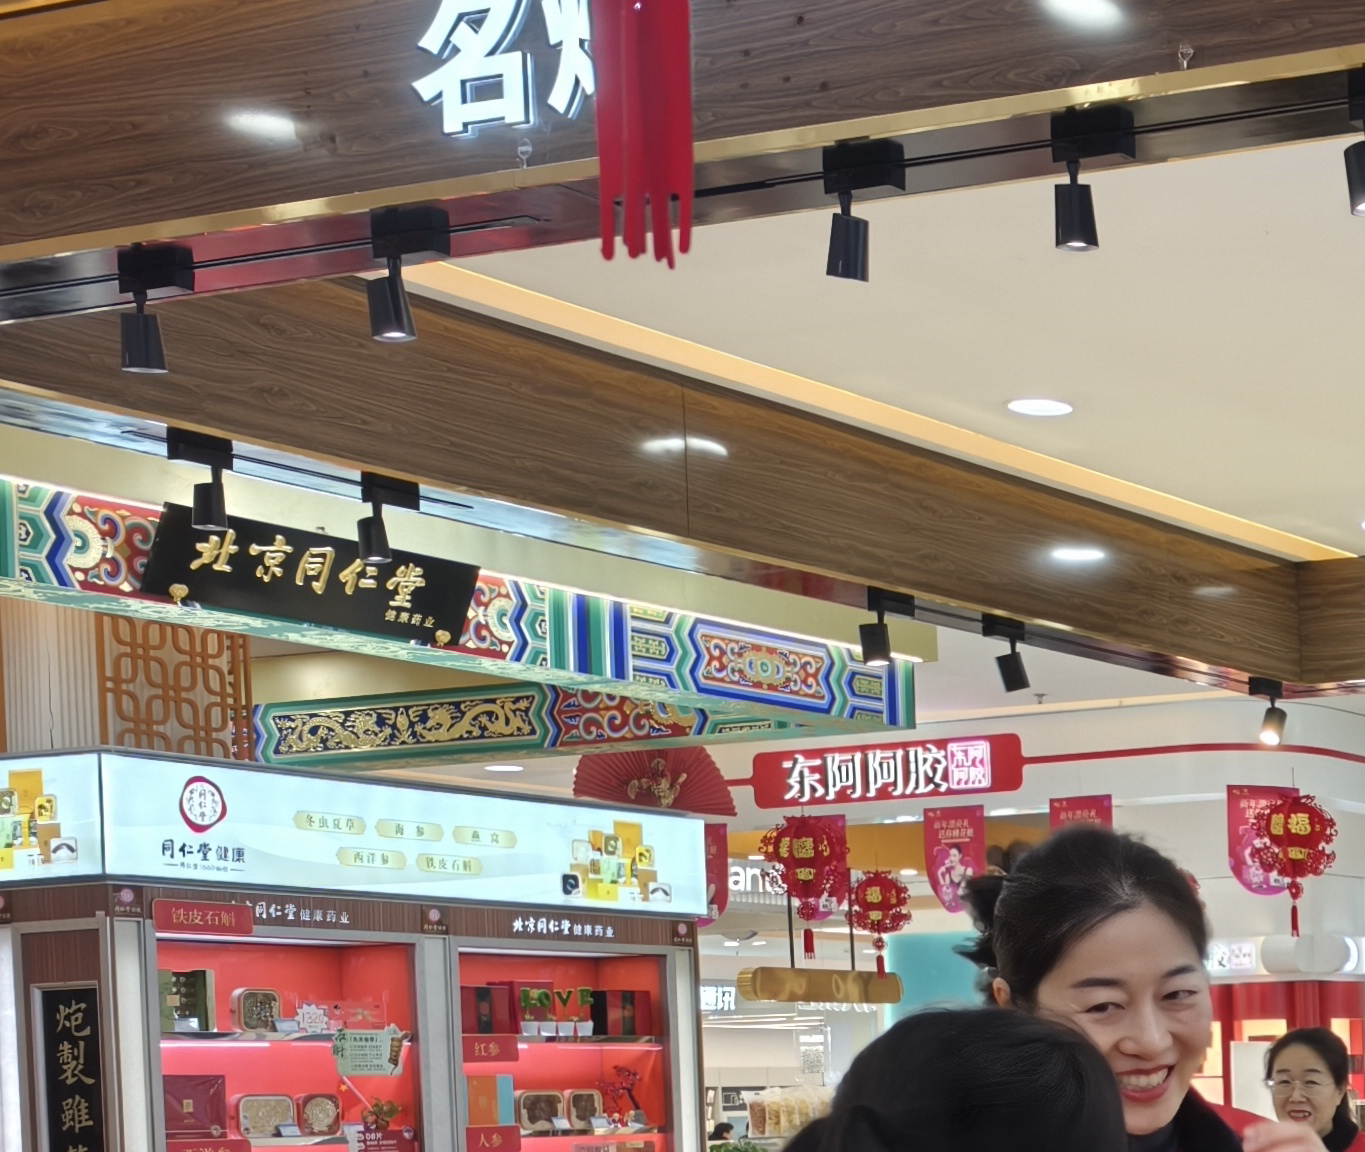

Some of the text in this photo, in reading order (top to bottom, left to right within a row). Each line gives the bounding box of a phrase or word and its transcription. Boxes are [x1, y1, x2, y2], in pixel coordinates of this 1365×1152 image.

[190, 529, 426, 609] 北京同仁堂
[384, 609, 436, 628] 健康药业
[782, 744, 948, 802] 东阿阿胶
[305, 814, 356, 831] 冬虫夏草
[162, 838, 246, 863] 同仁堂健康
[353, 851, 390, 865] 西洋参
[425, 856, 473, 872] 铁皮石斛
[171, 906, 236, 927] 铁皮石斛
[474, 1042, 501, 1057] 红参
[478, 1132, 503, 1148] 人参
